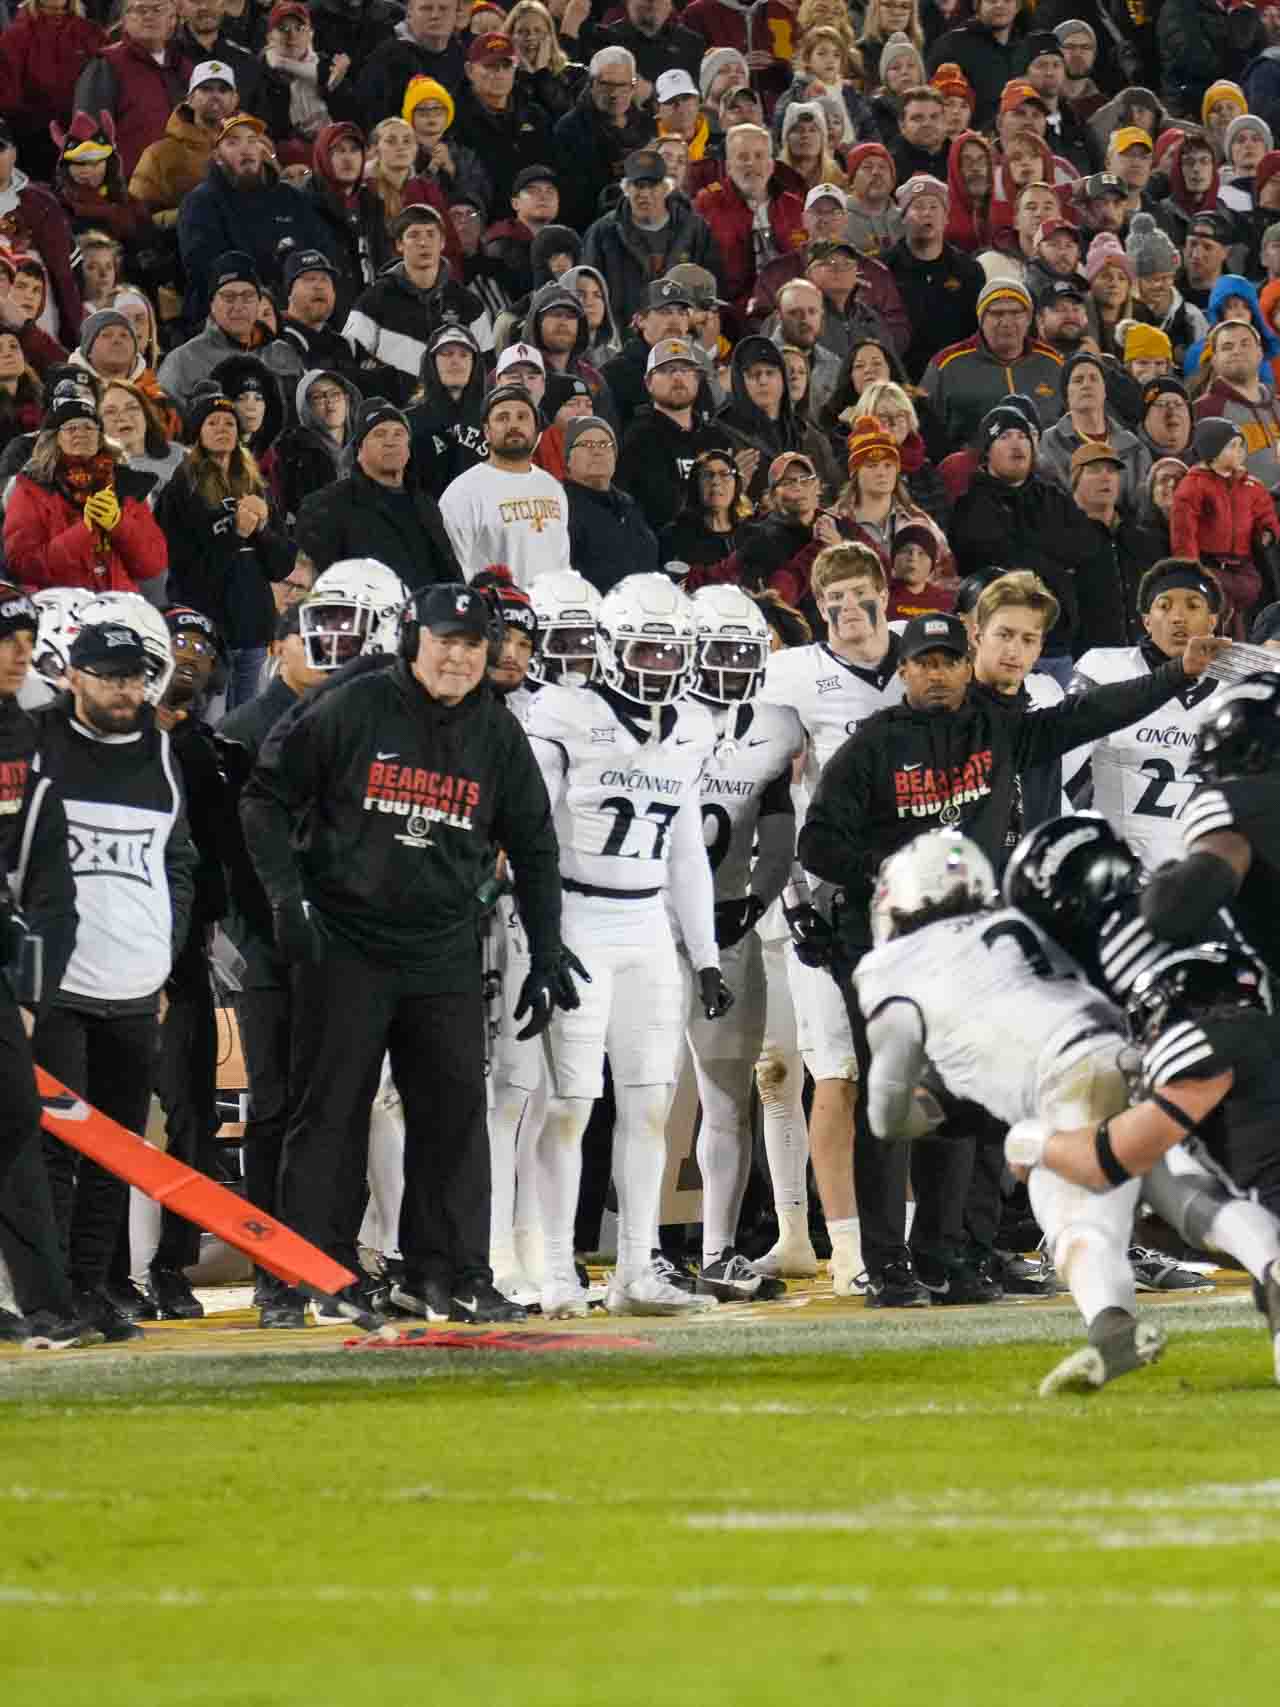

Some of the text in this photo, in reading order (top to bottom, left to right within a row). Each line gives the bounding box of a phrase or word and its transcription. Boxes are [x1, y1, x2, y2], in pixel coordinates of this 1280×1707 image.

[368, 762, 480, 807] BEARCATS
[600, 768, 682, 795] CINCINNATI
[702, 772, 754, 795] INNATI
[895, 750, 992, 797] BEARCATS
[363, 786, 473, 831] FOOTBALL
[600, 797, 680, 860] 27
